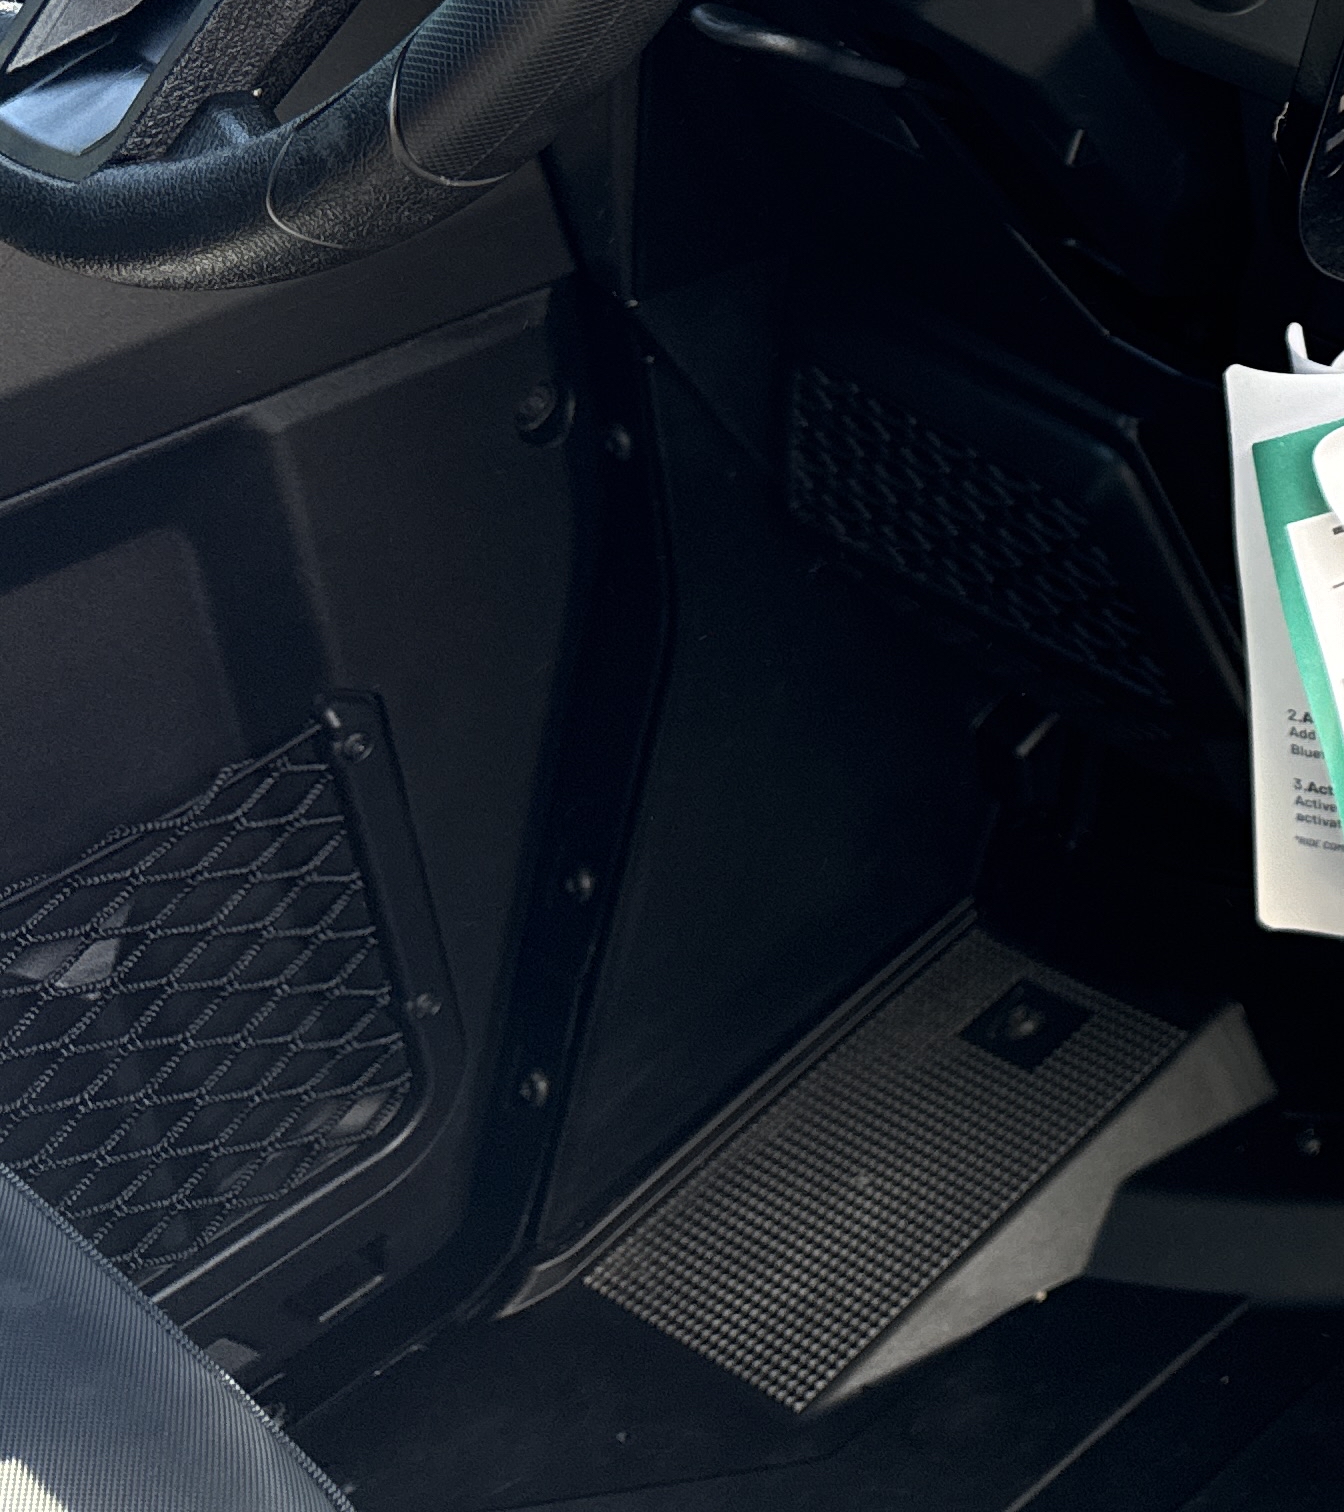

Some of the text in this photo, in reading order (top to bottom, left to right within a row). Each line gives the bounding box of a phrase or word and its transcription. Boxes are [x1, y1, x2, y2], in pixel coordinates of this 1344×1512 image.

[1287, 708, 1314, 723] 2.A
[1293, 778, 1335, 796] 3.Act
[1296, 813, 1342, 829] activat
